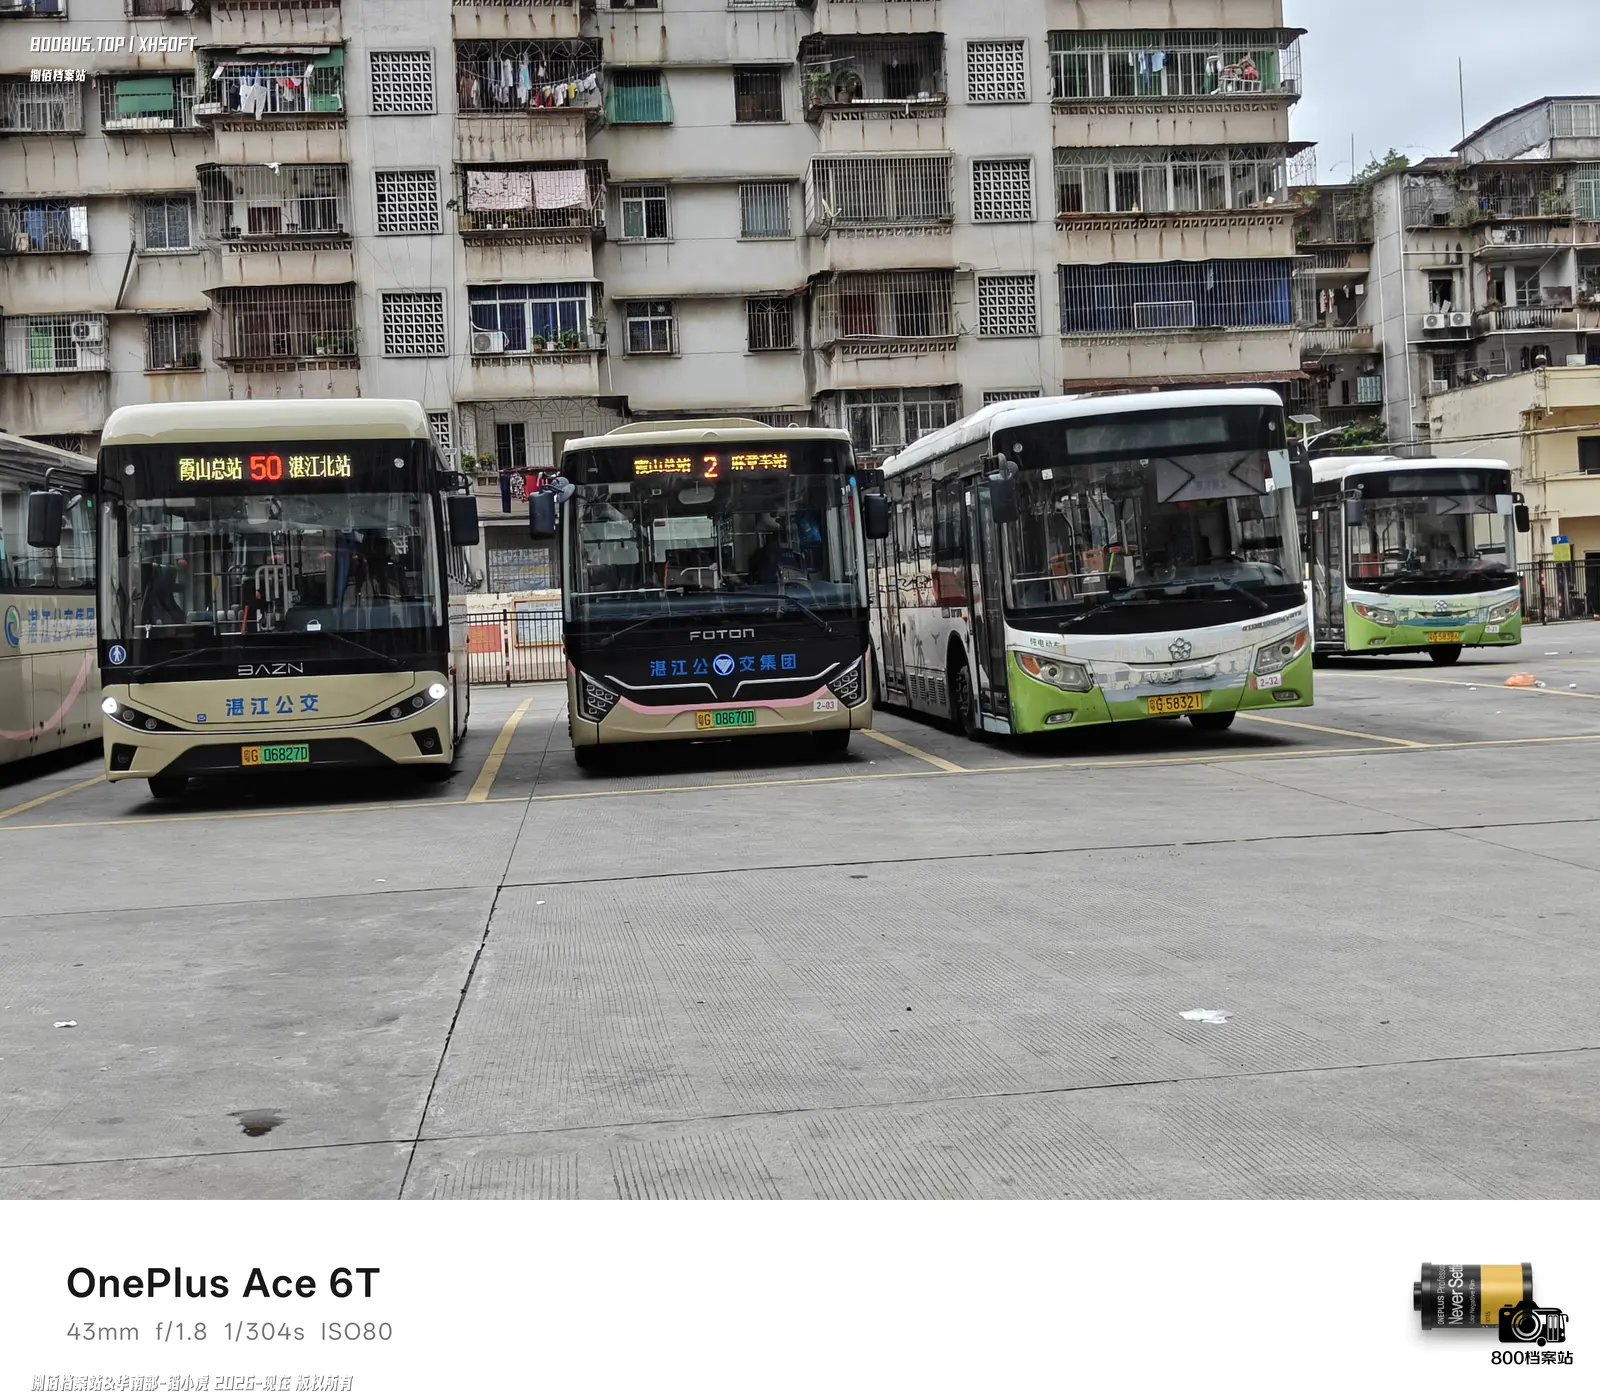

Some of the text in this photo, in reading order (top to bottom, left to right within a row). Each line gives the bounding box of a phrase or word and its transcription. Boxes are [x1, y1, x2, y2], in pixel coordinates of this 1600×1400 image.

[179, 454, 351, 481] 霞山总站 50 湛江北站
[703, 454, 718, 478] 2
[689, 628, 755, 641] FOTON
[238, 662, 304, 676] BAZN
[1260, 677, 1278, 687] 2-32
[226, 693, 319, 716] 湛江公交
[816, 701, 835, 710] 2-03
